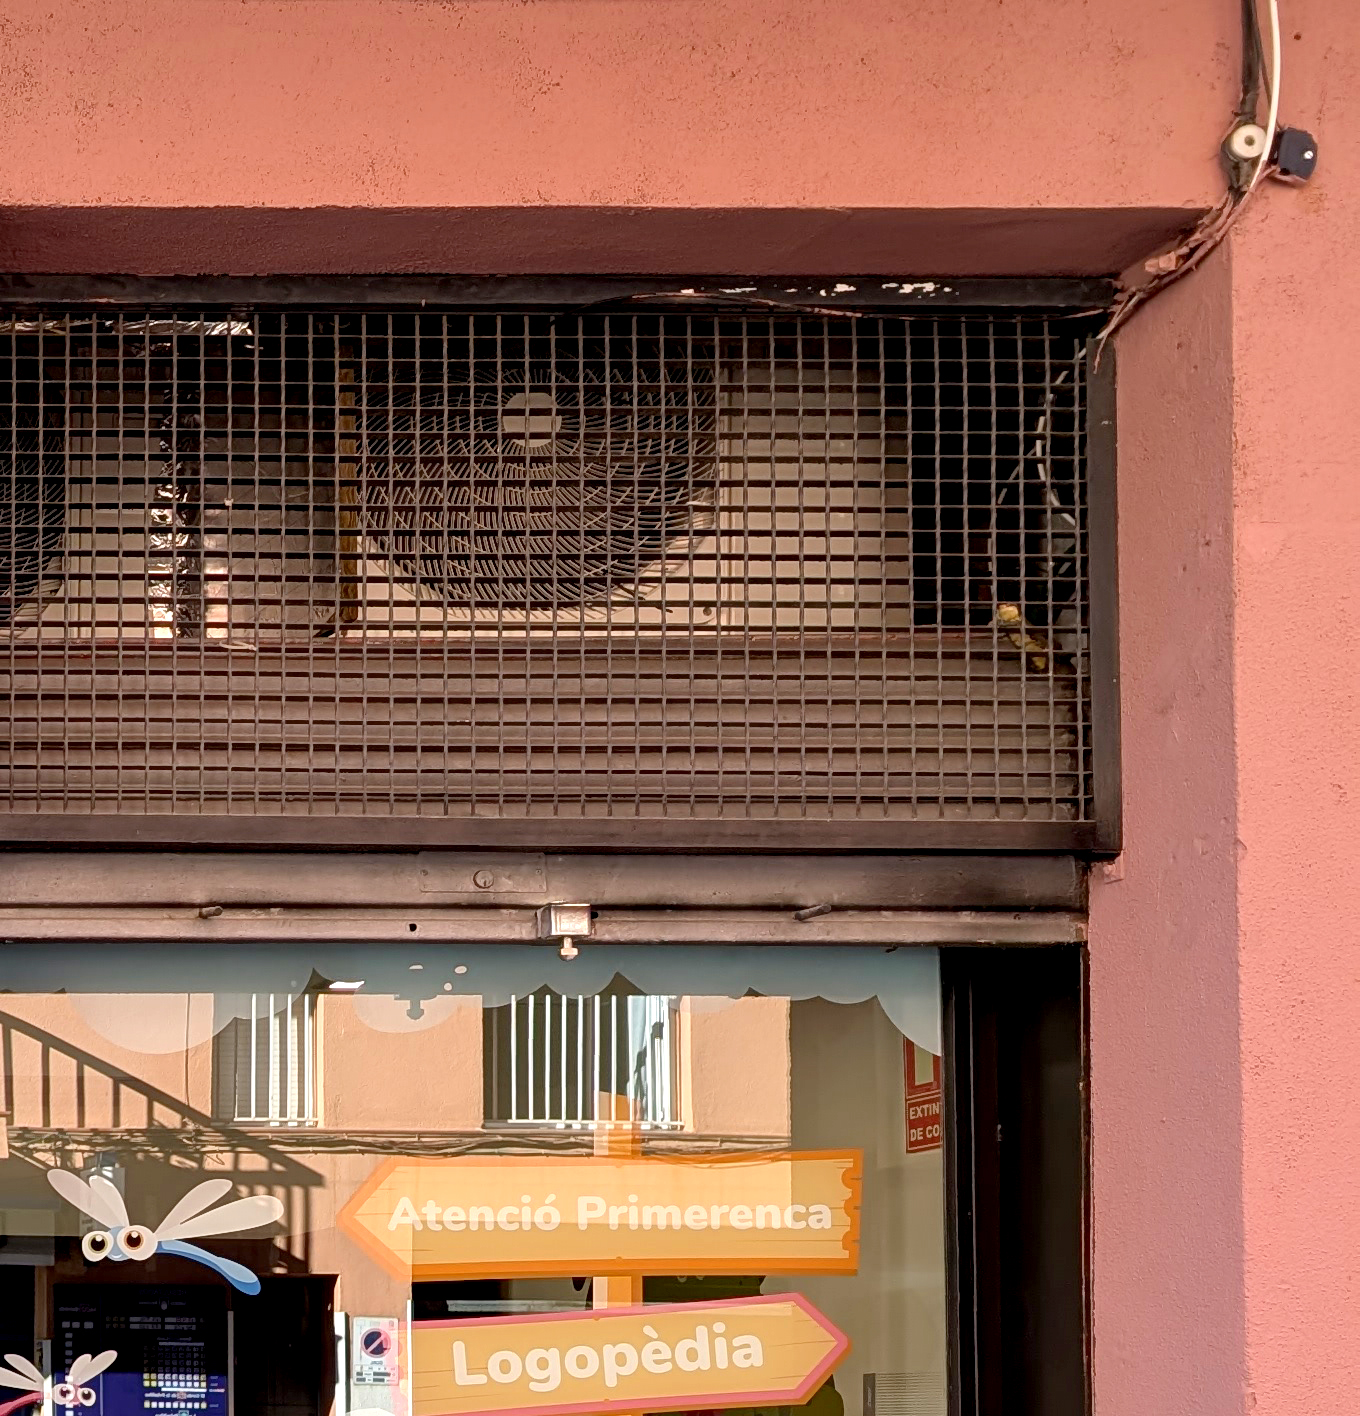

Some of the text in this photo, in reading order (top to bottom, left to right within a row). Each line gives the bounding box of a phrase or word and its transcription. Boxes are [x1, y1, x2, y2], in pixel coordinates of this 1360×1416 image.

[910, 1128, 924, 1141] DE
[387, 1194, 833, 1231] Atenció Primerenca
[452, 1322, 765, 1392] Logopèdia
